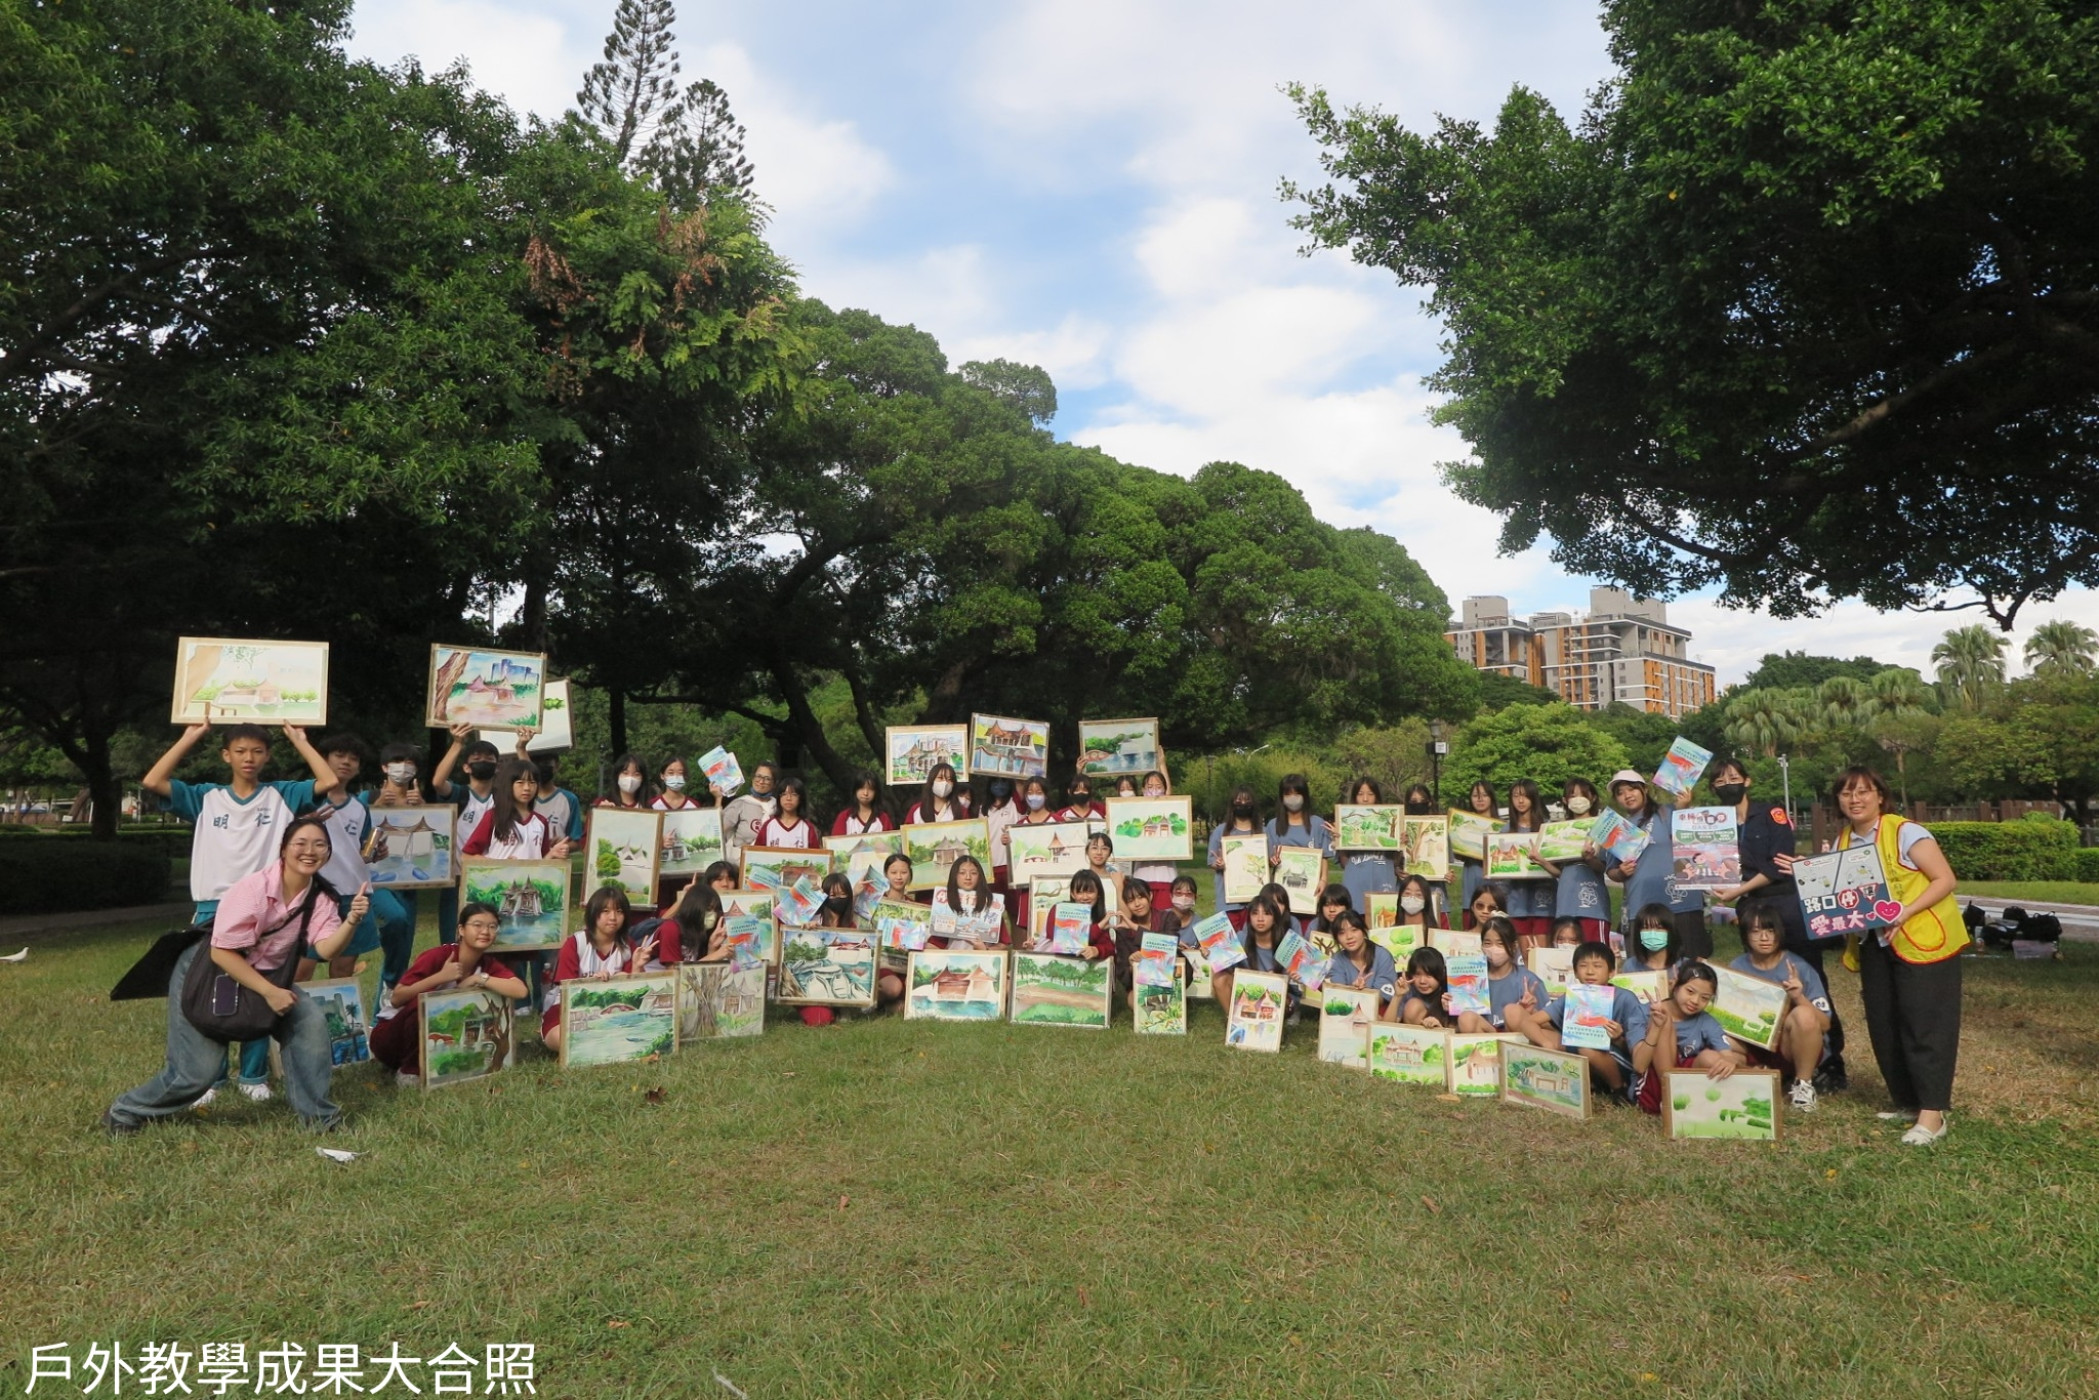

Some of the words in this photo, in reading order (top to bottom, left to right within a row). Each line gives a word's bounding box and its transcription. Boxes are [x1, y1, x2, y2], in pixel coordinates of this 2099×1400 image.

[213, 814, 230, 829] 明
[255, 812, 272, 827] 仁
[344, 823, 357, 836] 仁
[1810, 910, 1865, 936] 愛最大
